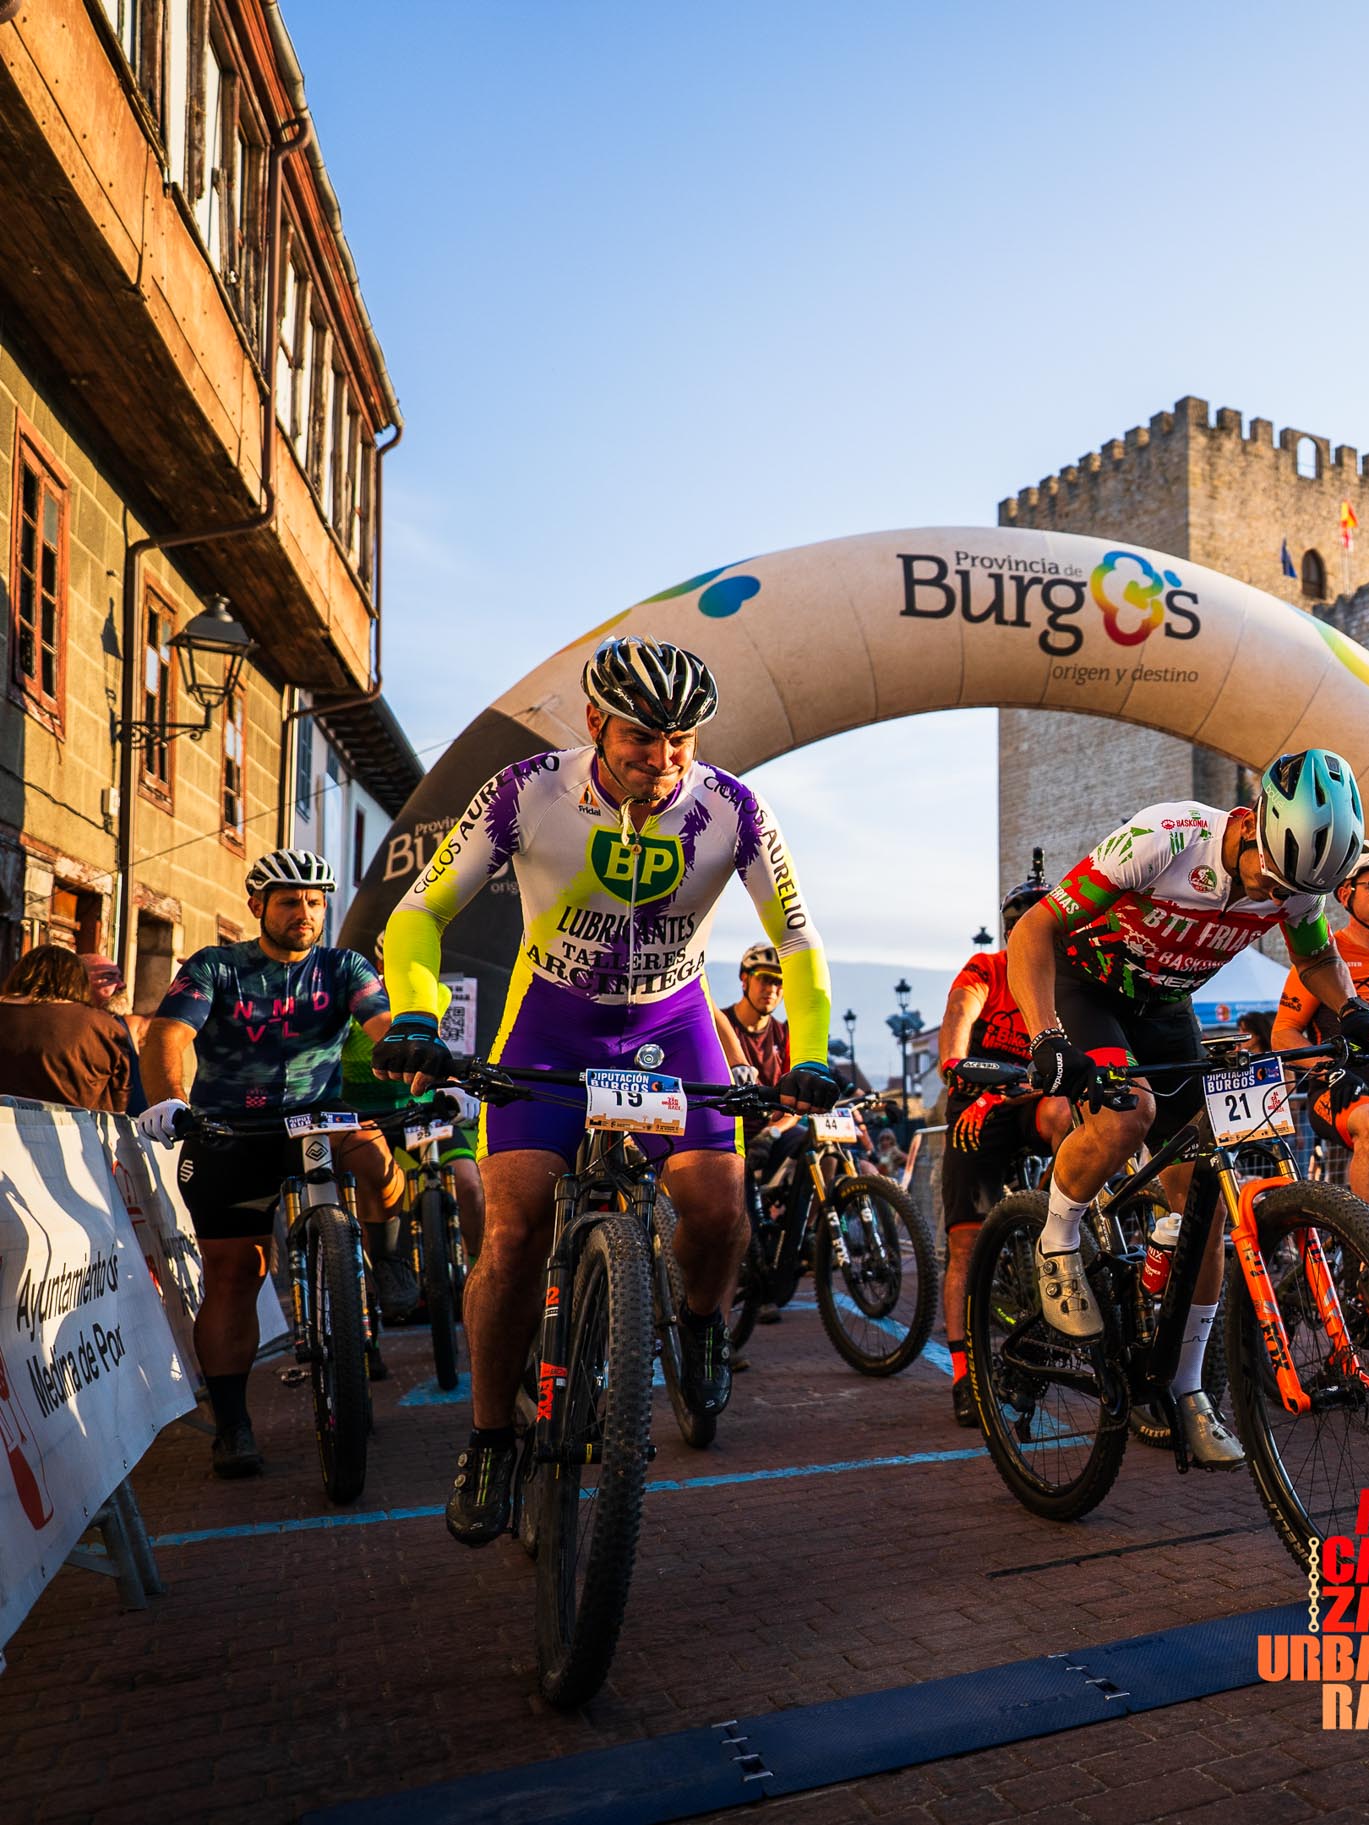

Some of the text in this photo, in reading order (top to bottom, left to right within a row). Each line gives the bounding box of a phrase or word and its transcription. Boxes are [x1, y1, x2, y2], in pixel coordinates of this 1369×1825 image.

[955, 550, 1083, 578] Provincia de
[897, 552, 1202, 657] Burgos
[1052, 664, 1199, 686] origen y destino
[415, 815, 459, 836] Provin
[1176, 819, 1209, 828] BASKONIA
[603, 840, 674, 885] BP
[489, 880, 519, 894] orig
[762, 828, 807, 931] AURELIO
[556, 905, 696, 946] LUBRICANTES
[1142, 906, 1199, 943] BTT
[562, 941, 686, 971] TALLERES
[1207, 1075, 1256, 1094] BURGOS
[1224, 1093, 1251, 1122] 21
[825, 1119, 838, 1130] 44
[16, 1250, 105, 1342] Ayuntamiento
[26, 1344, 83, 1418] Medina
[79, 1330, 100, 1385] de
[966, 1327, 981, 1403] PIRELLI
[1268, 1503, 1311, 1566] IRELLI
